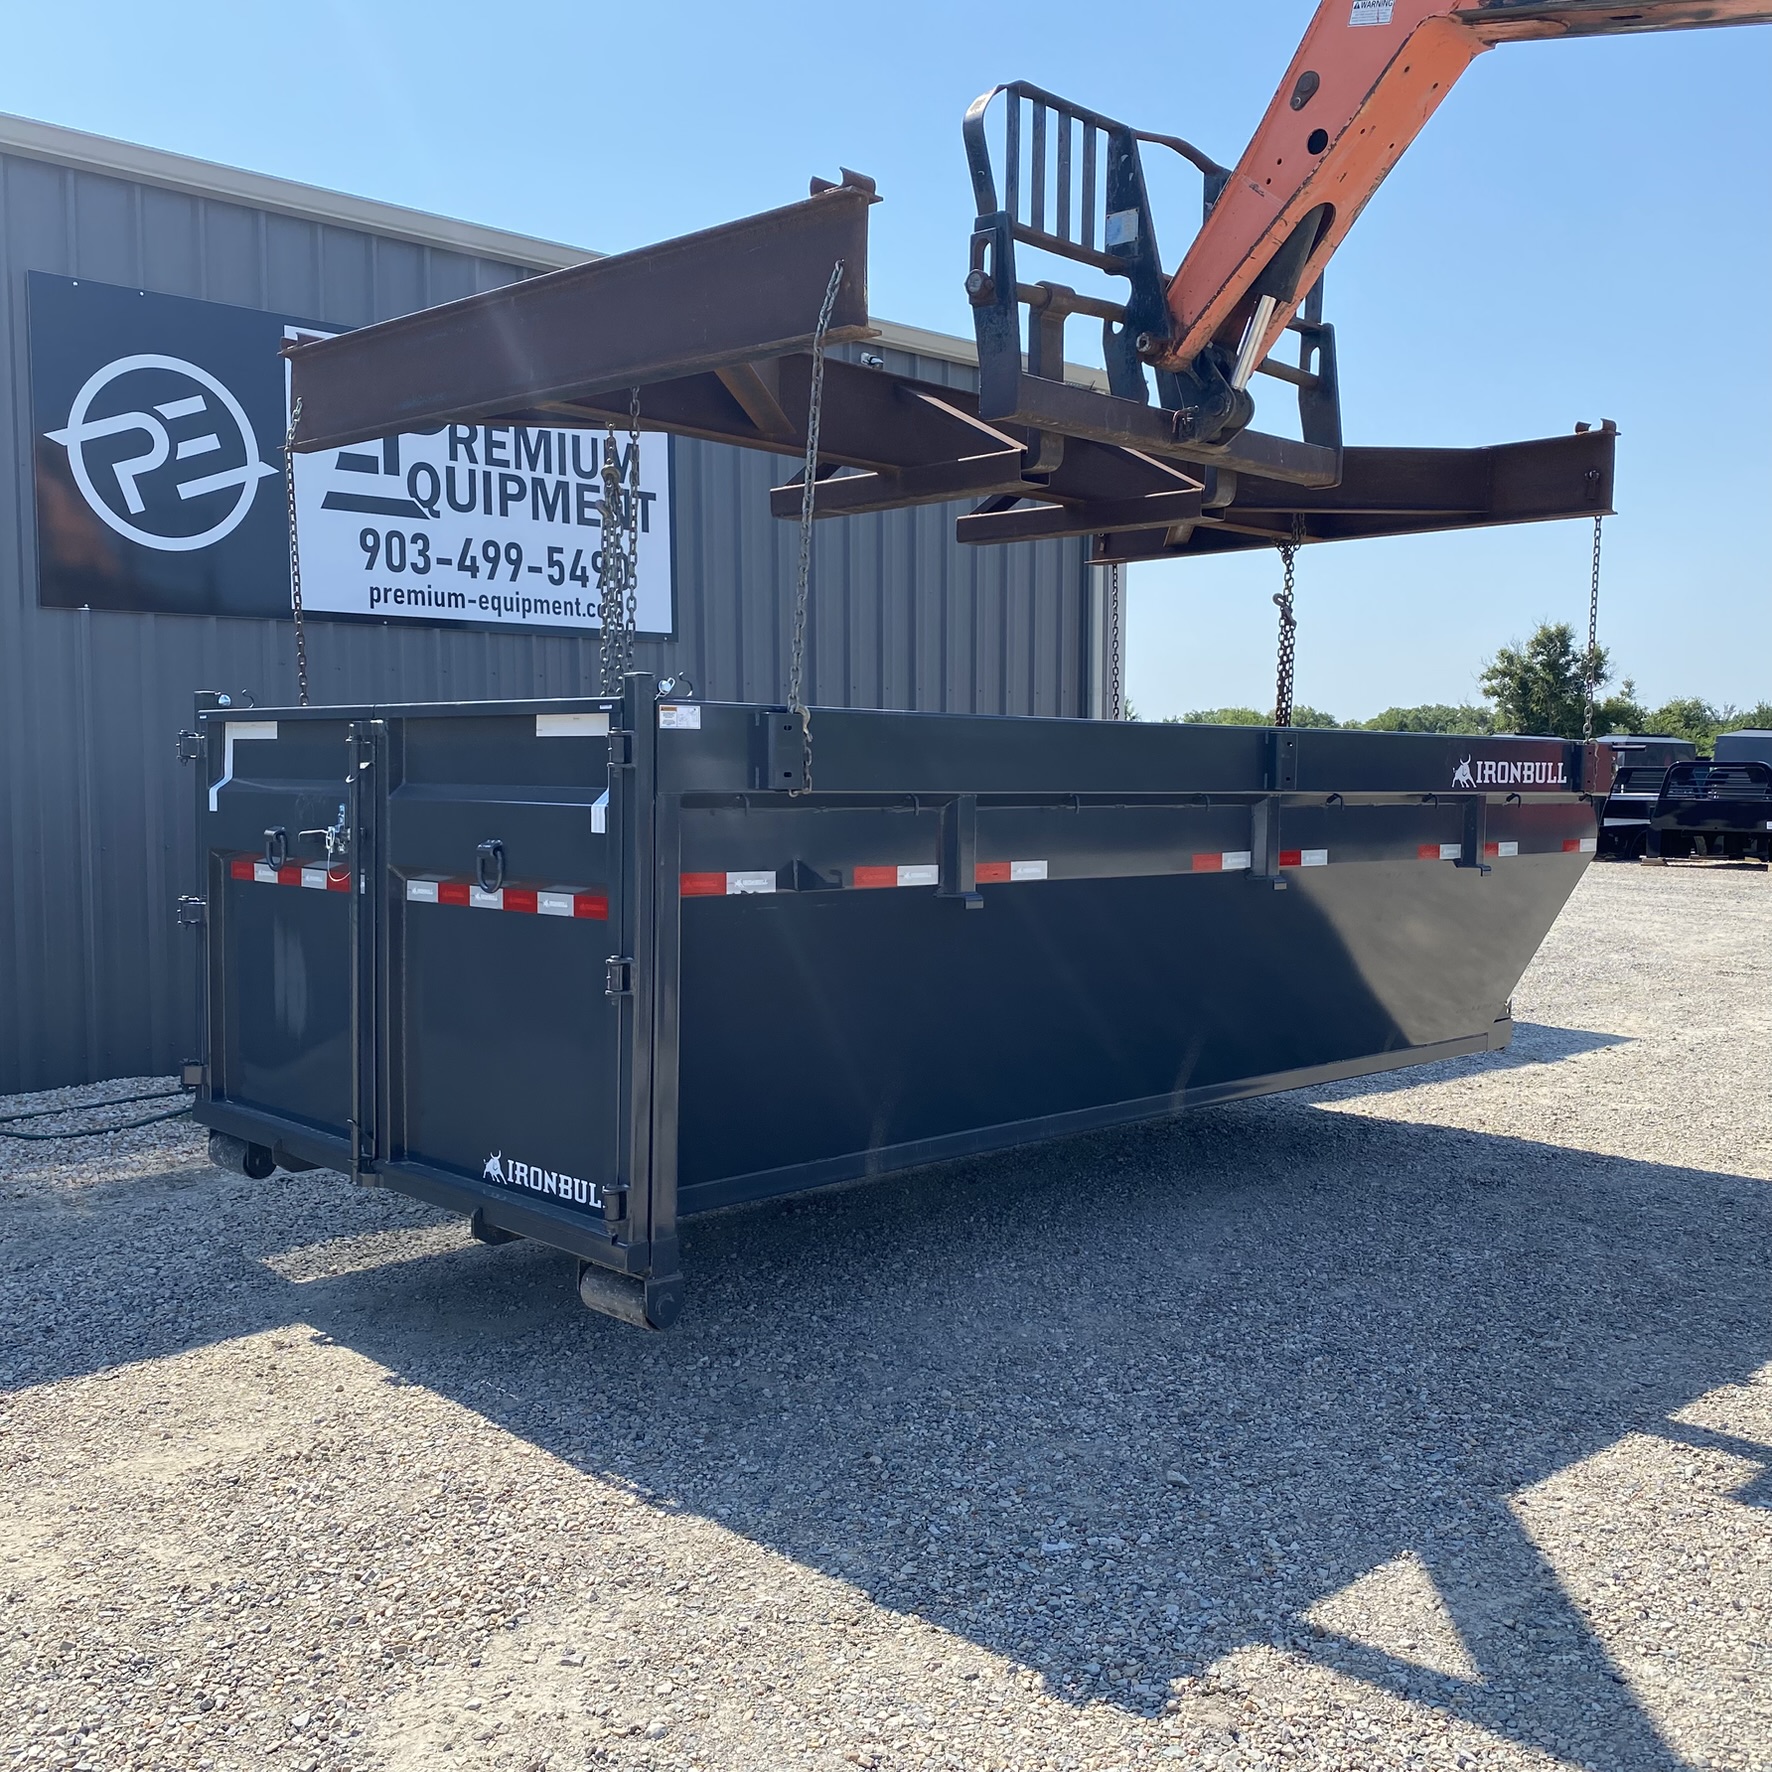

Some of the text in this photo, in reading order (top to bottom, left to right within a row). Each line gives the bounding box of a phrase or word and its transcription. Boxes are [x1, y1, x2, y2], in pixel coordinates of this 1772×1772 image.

[1361, 0, 1393, 9] WARNING
[1475, 761, 1568, 784] IRONBULL
[507, 1159, 606, 1209] IRONBUL
